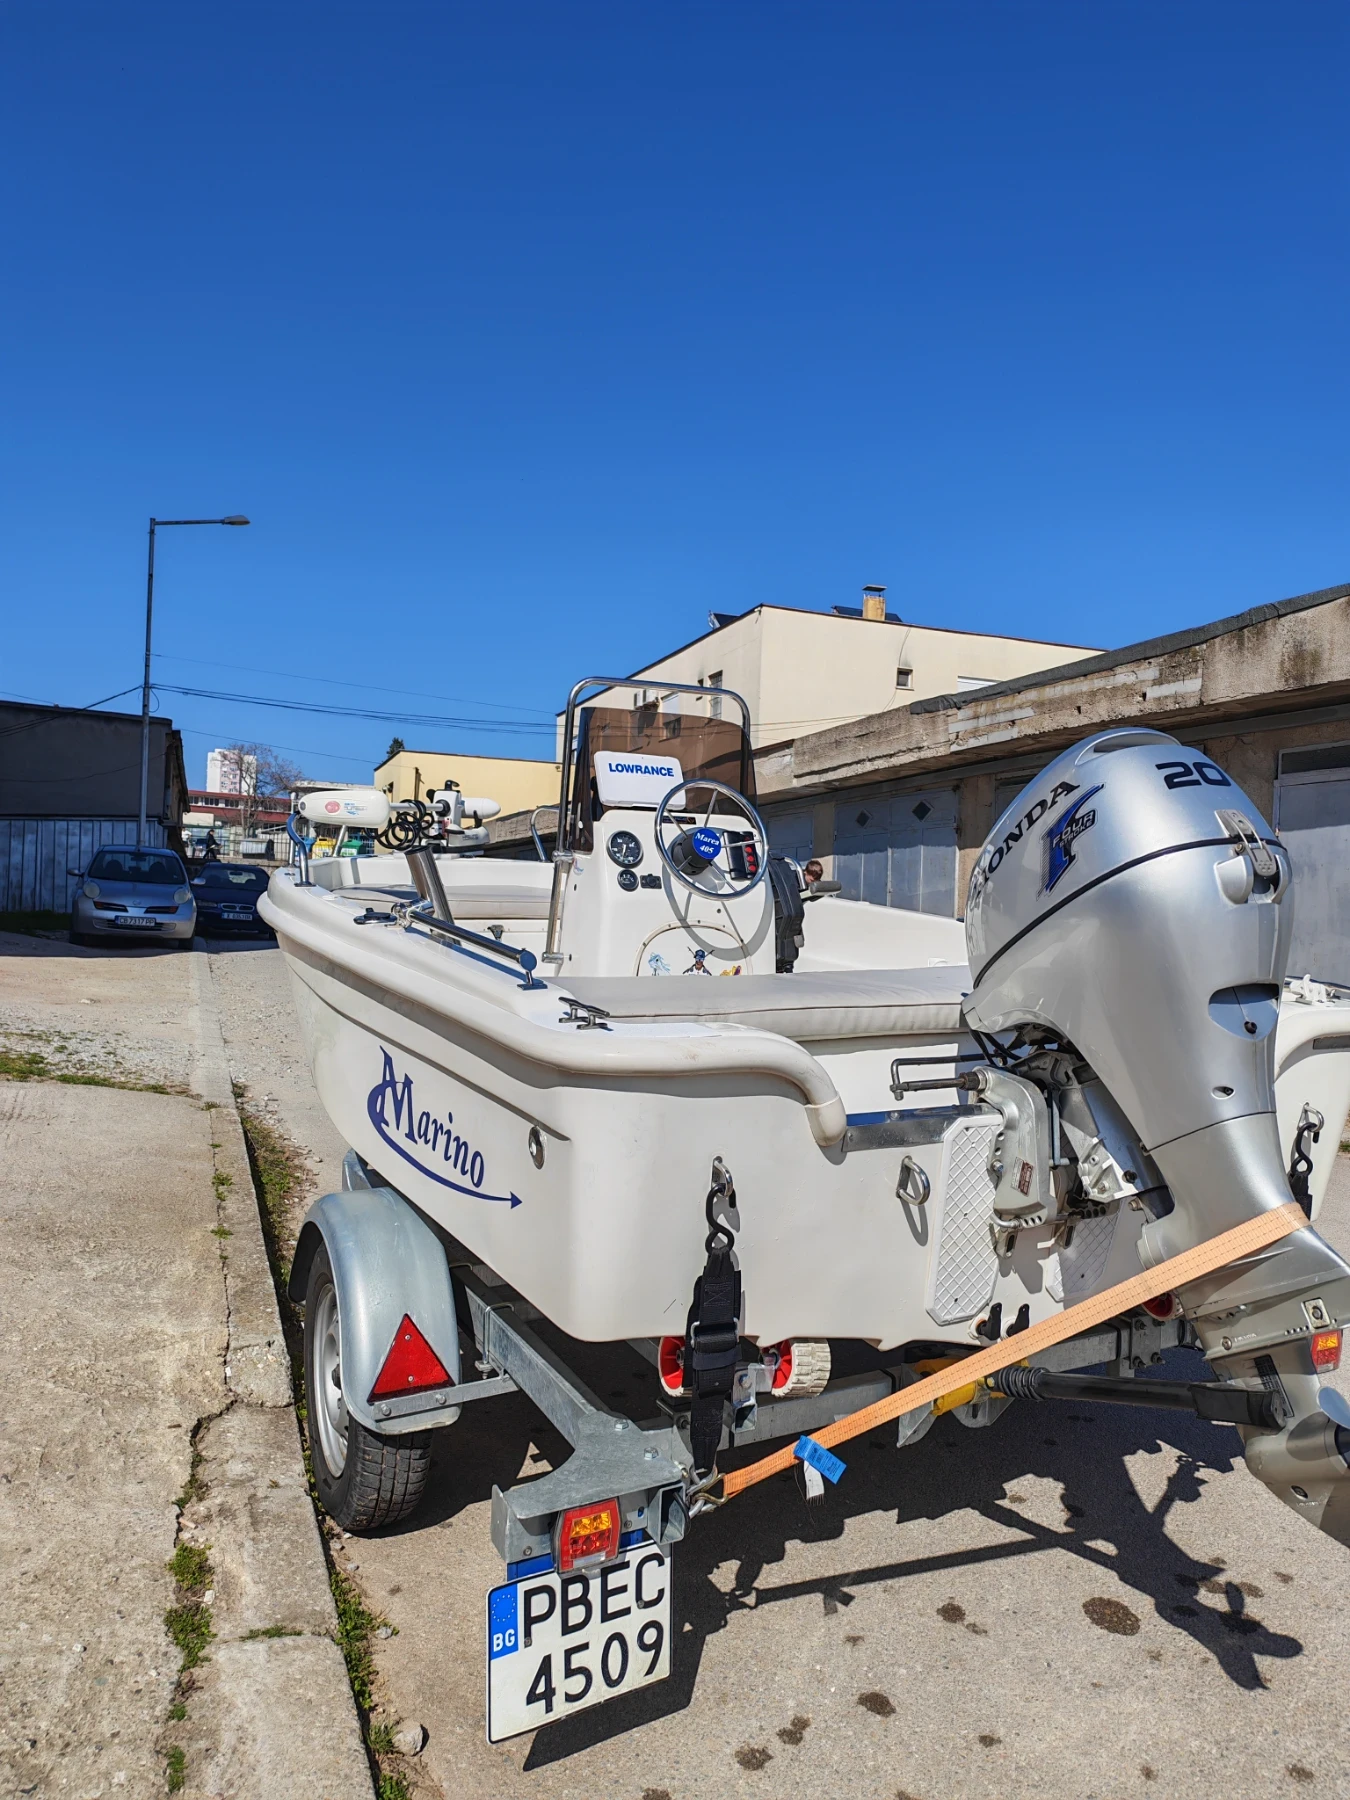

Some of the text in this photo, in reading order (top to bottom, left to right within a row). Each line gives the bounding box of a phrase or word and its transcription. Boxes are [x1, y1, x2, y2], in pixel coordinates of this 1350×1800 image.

[608, 762, 675, 777] LOWRANCE
[1155, 761, 1232, 790] 20
[695, 832, 720, 846] Marea
[1053, 811, 1094, 848] FOUR
[699, 844, 715, 855] 405
[367, 1045, 485, 1188] Marino
[524, 1552, 665, 1649] PBEC
[493, 1628, 515, 1652] BG
[526, 1620, 664, 1714] 4509
